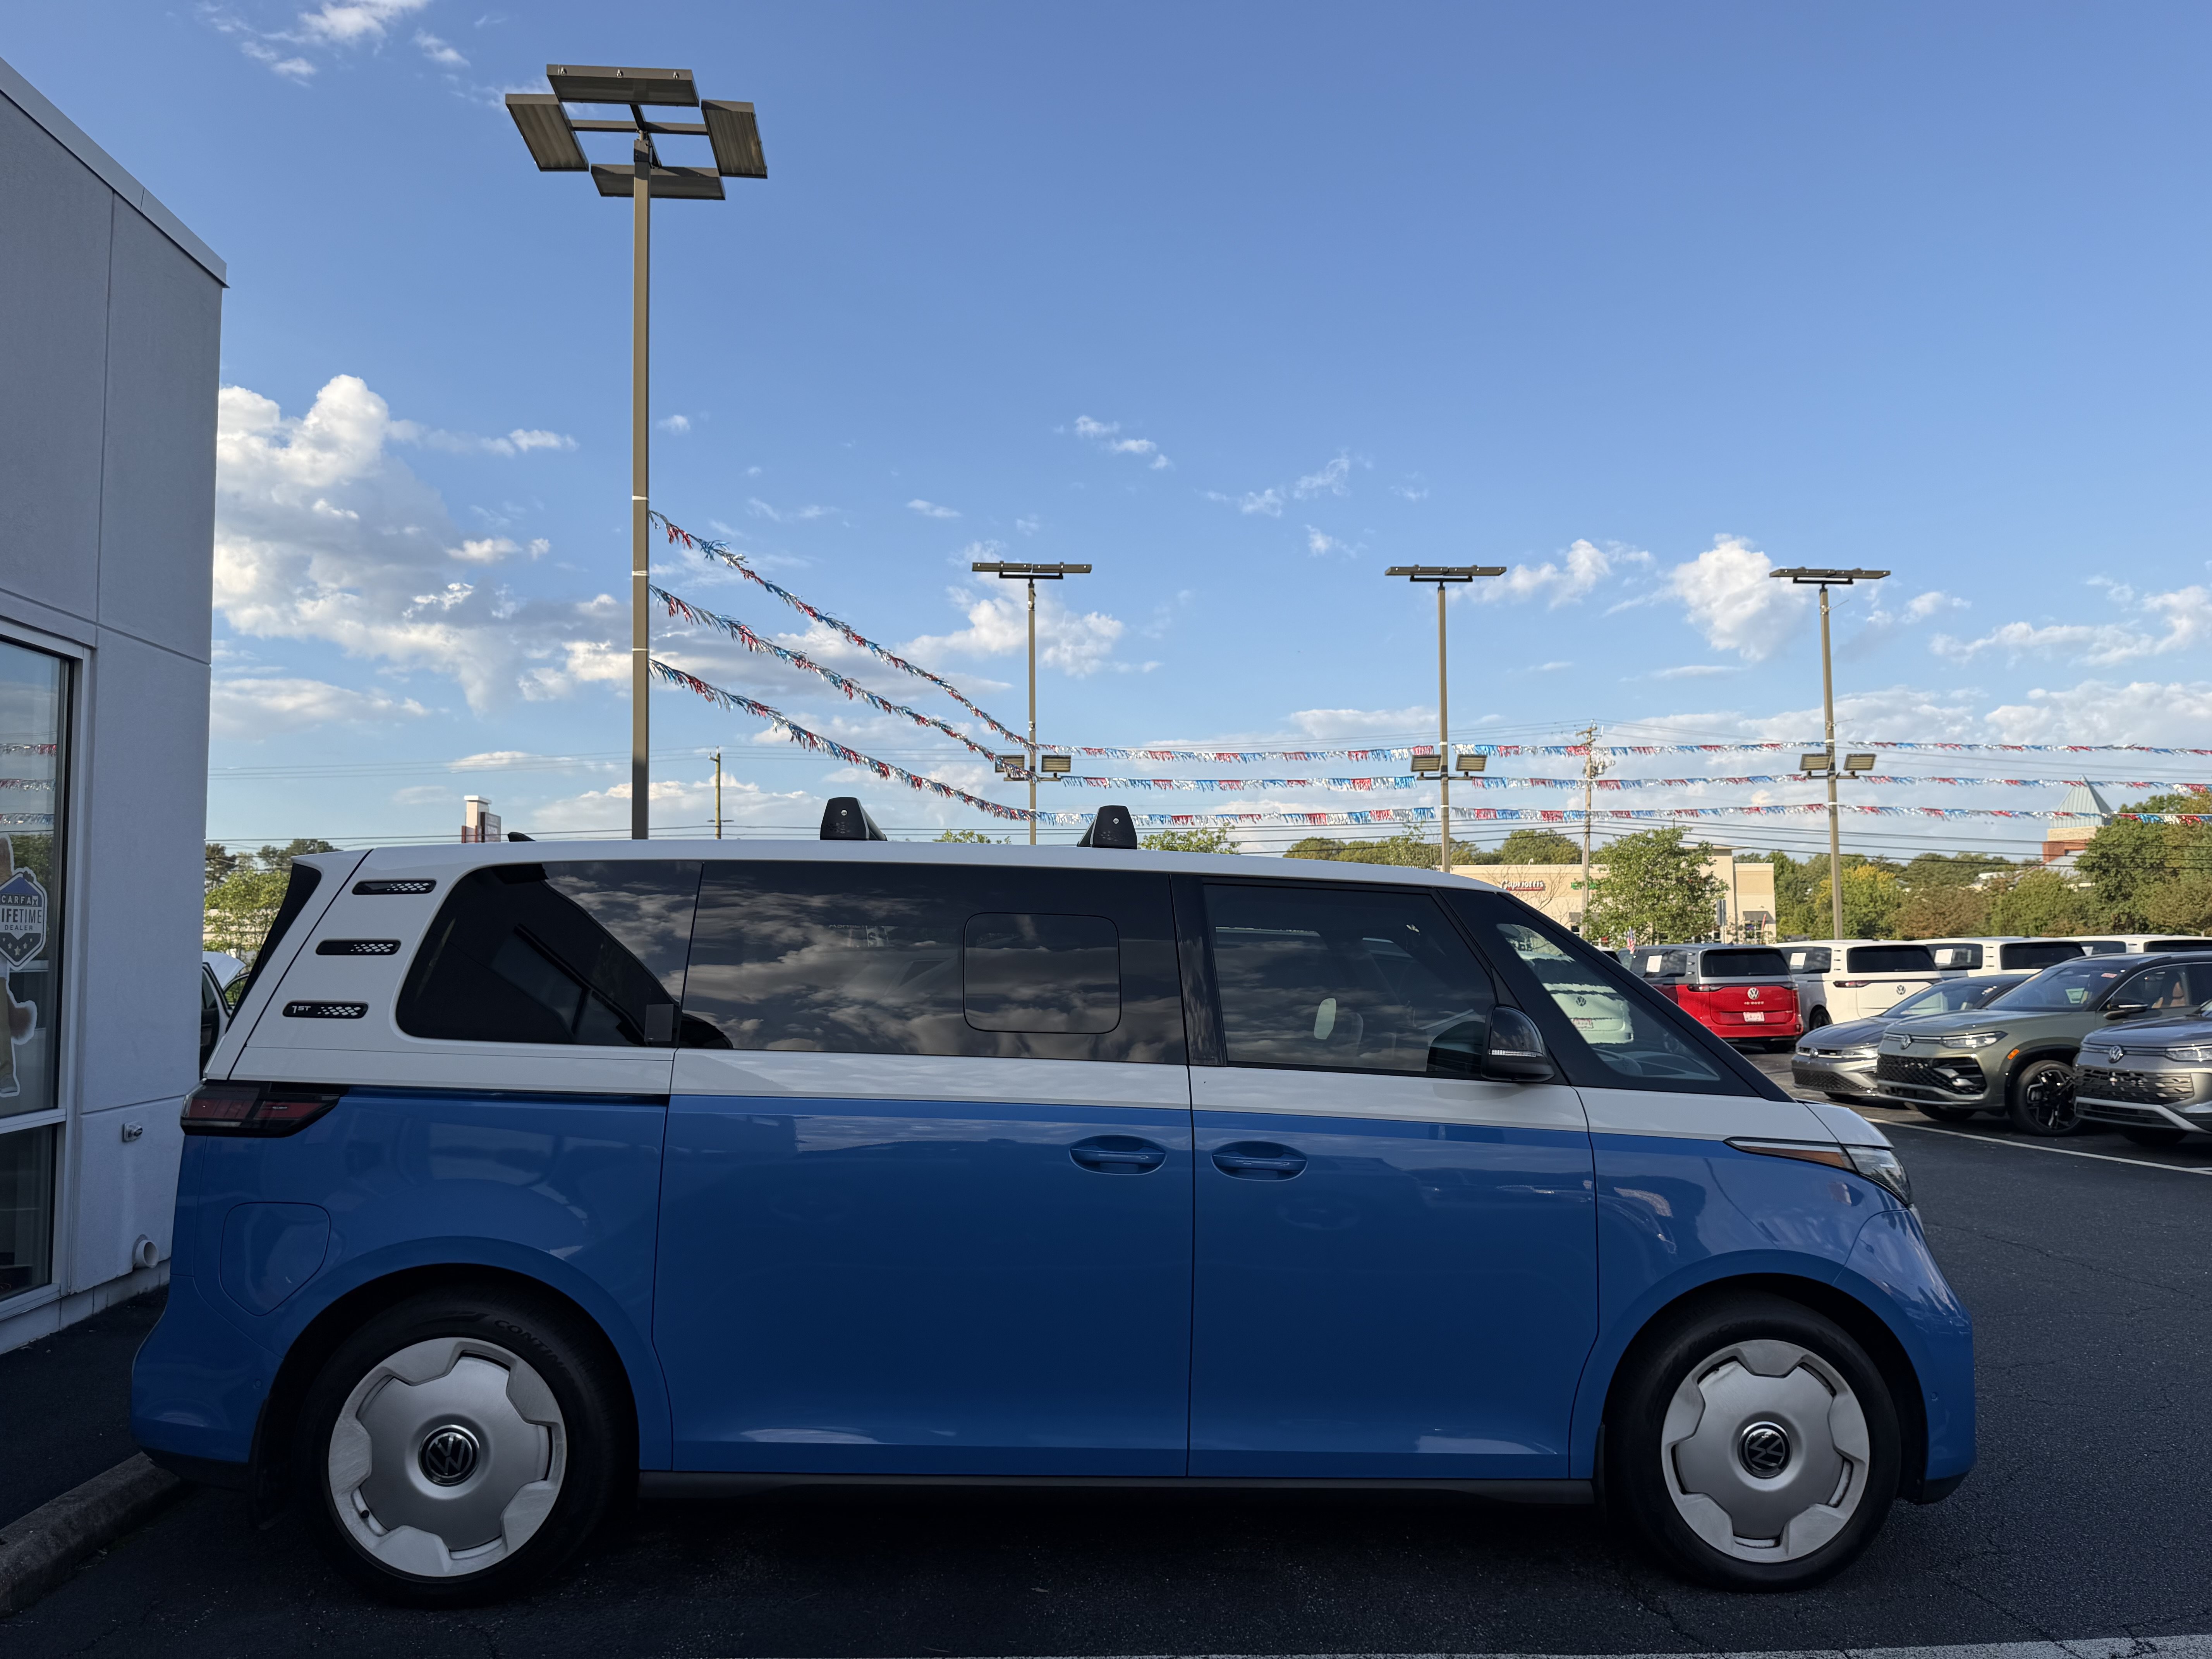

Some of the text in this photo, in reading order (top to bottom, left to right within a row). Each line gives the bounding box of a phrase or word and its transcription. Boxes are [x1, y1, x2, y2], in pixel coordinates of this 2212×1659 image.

[1, 895, 37, 906] CARFAX
[0, 908, 42, 924] IFETIME
[292, 1005, 311, 1013] 1ST
